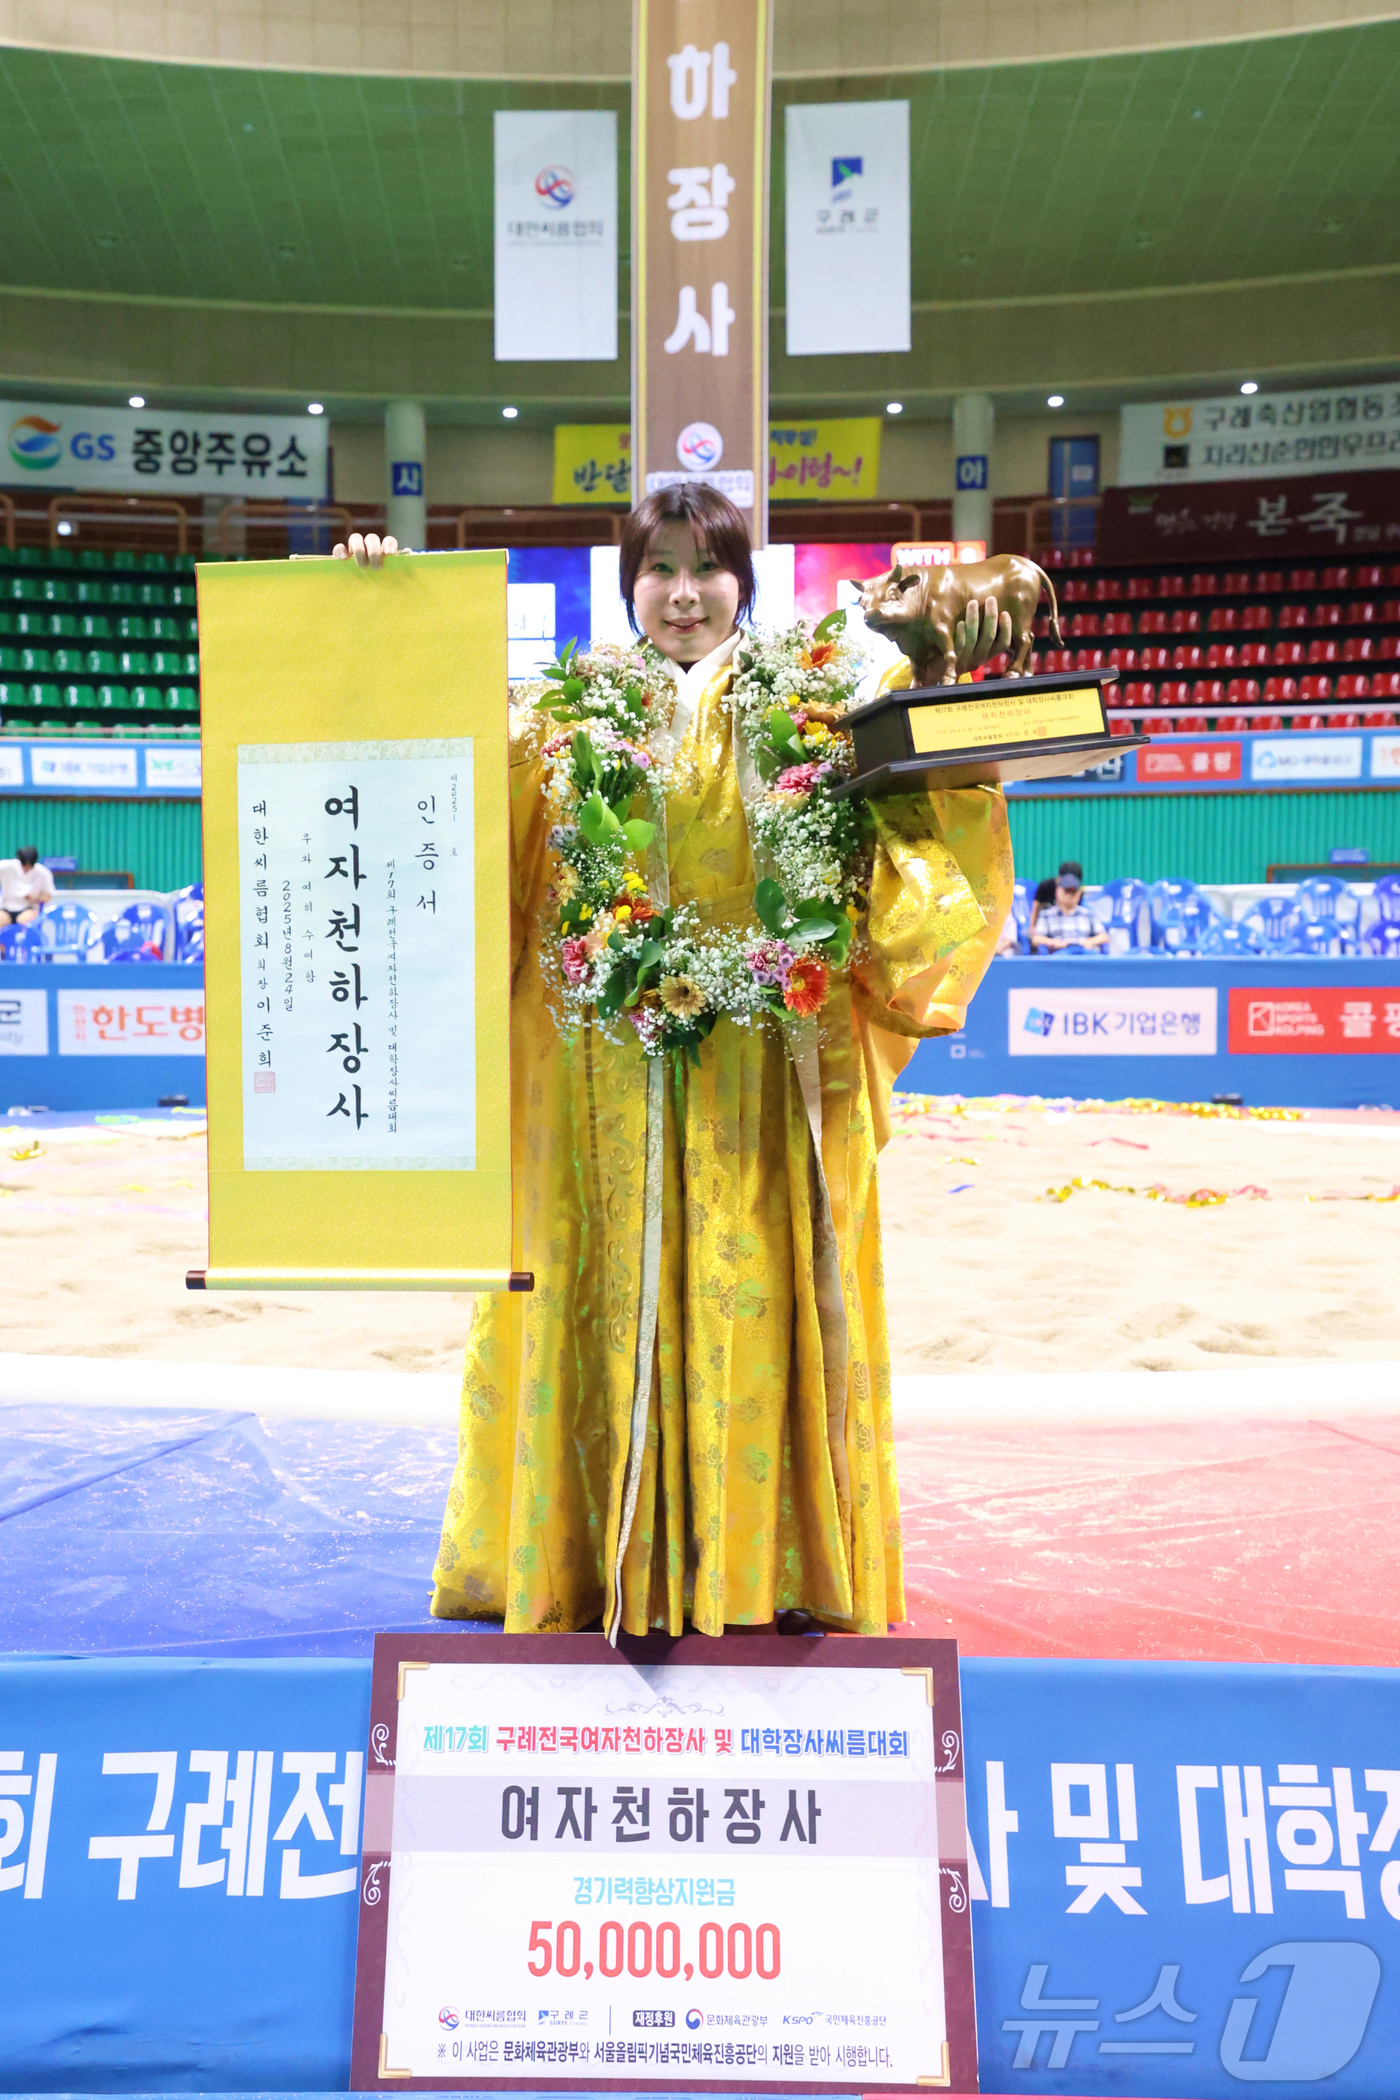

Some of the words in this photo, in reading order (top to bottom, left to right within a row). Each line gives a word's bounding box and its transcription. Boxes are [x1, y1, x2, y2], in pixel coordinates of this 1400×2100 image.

[664, 42, 738, 357] 하장사
[71, 432, 116, 461] GS
[132, 428, 308, 478] 중앙주유소
[414, 794, 440, 915] 인증서
[323, 784, 369, 1131] 여자천하장사
[423, 1725, 487, 1751] 제17회
[496, 1725, 706, 1753] 구례전국여자천하장사
[713, 1729, 732, 1753] 및
[741, 1728, 908, 1757] 대학장사씨름대회
[88, 1750, 363, 1901] 구례전
[1050, 1763, 1149, 1916] 및
[500, 1784, 822, 1845] 여자천하장사
[573, 1875, 736, 1908] 경기력향상지원금
[527, 1920, 782, 1981] 50,000,000
[465, 2009, 526, 2022] 대한씨름협회
[635, 2012, 673, 2027] 재정후원
[706, 2014, 768, 2026] 문화체육관광부
[782, 2014, 813, 2025] KSPO
[825, 2014, 887, 2026] 국민체육진흥공단
[452, 2040, 463, 2062] 이
[467, 2040, 499, 2062] 사업은
[503, 2040, 590, 2063] 문화체육관광부와
[594, 2041, 767, 2065] 서울올림픽기념국민체육진흥공단의
[772, 2044, 804, 2065] 지원을
[809, 2045, 830, 2066] 받아
[835, 2046, 893, 2068] 시행합니다.
